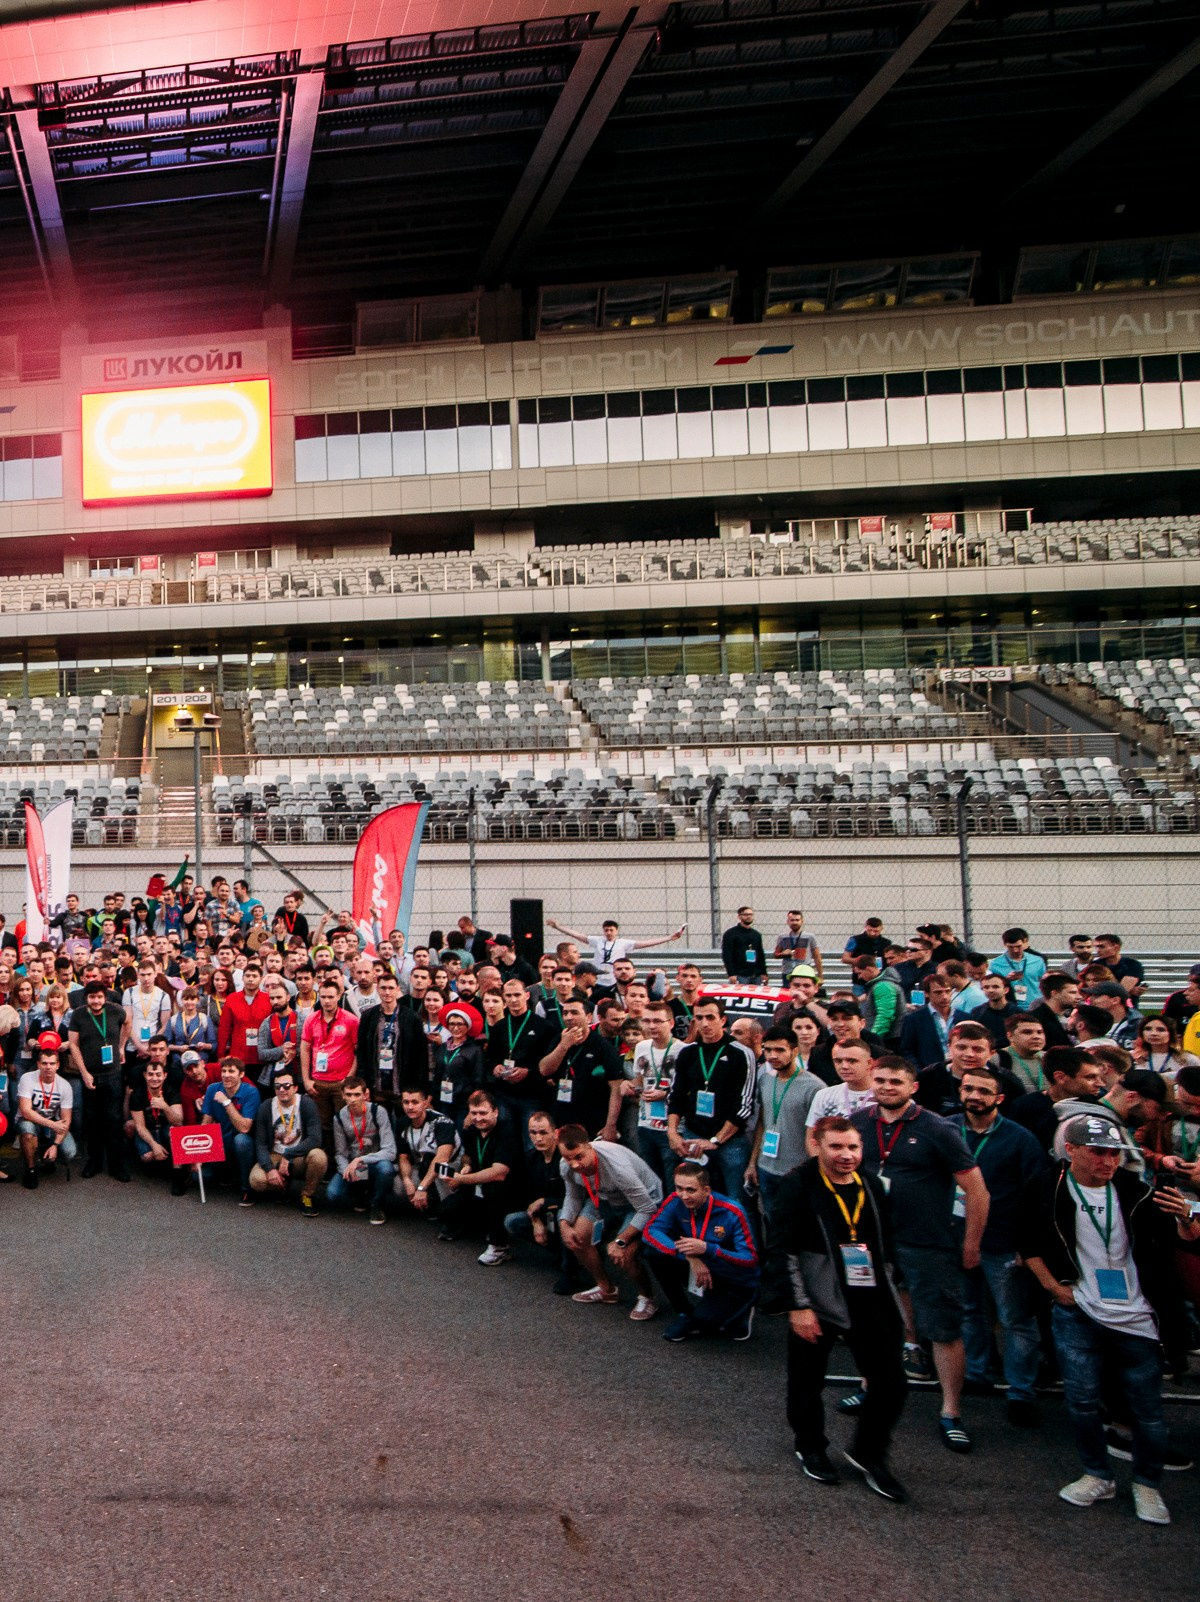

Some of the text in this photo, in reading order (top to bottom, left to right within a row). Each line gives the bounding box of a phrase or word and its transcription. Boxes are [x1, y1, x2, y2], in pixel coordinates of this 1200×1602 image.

[131, 349, 243, 378] ЛУКОЙЛ
[335, 366, 444, 395] SOCHI
[156, 694, 208, 704] 201 202
